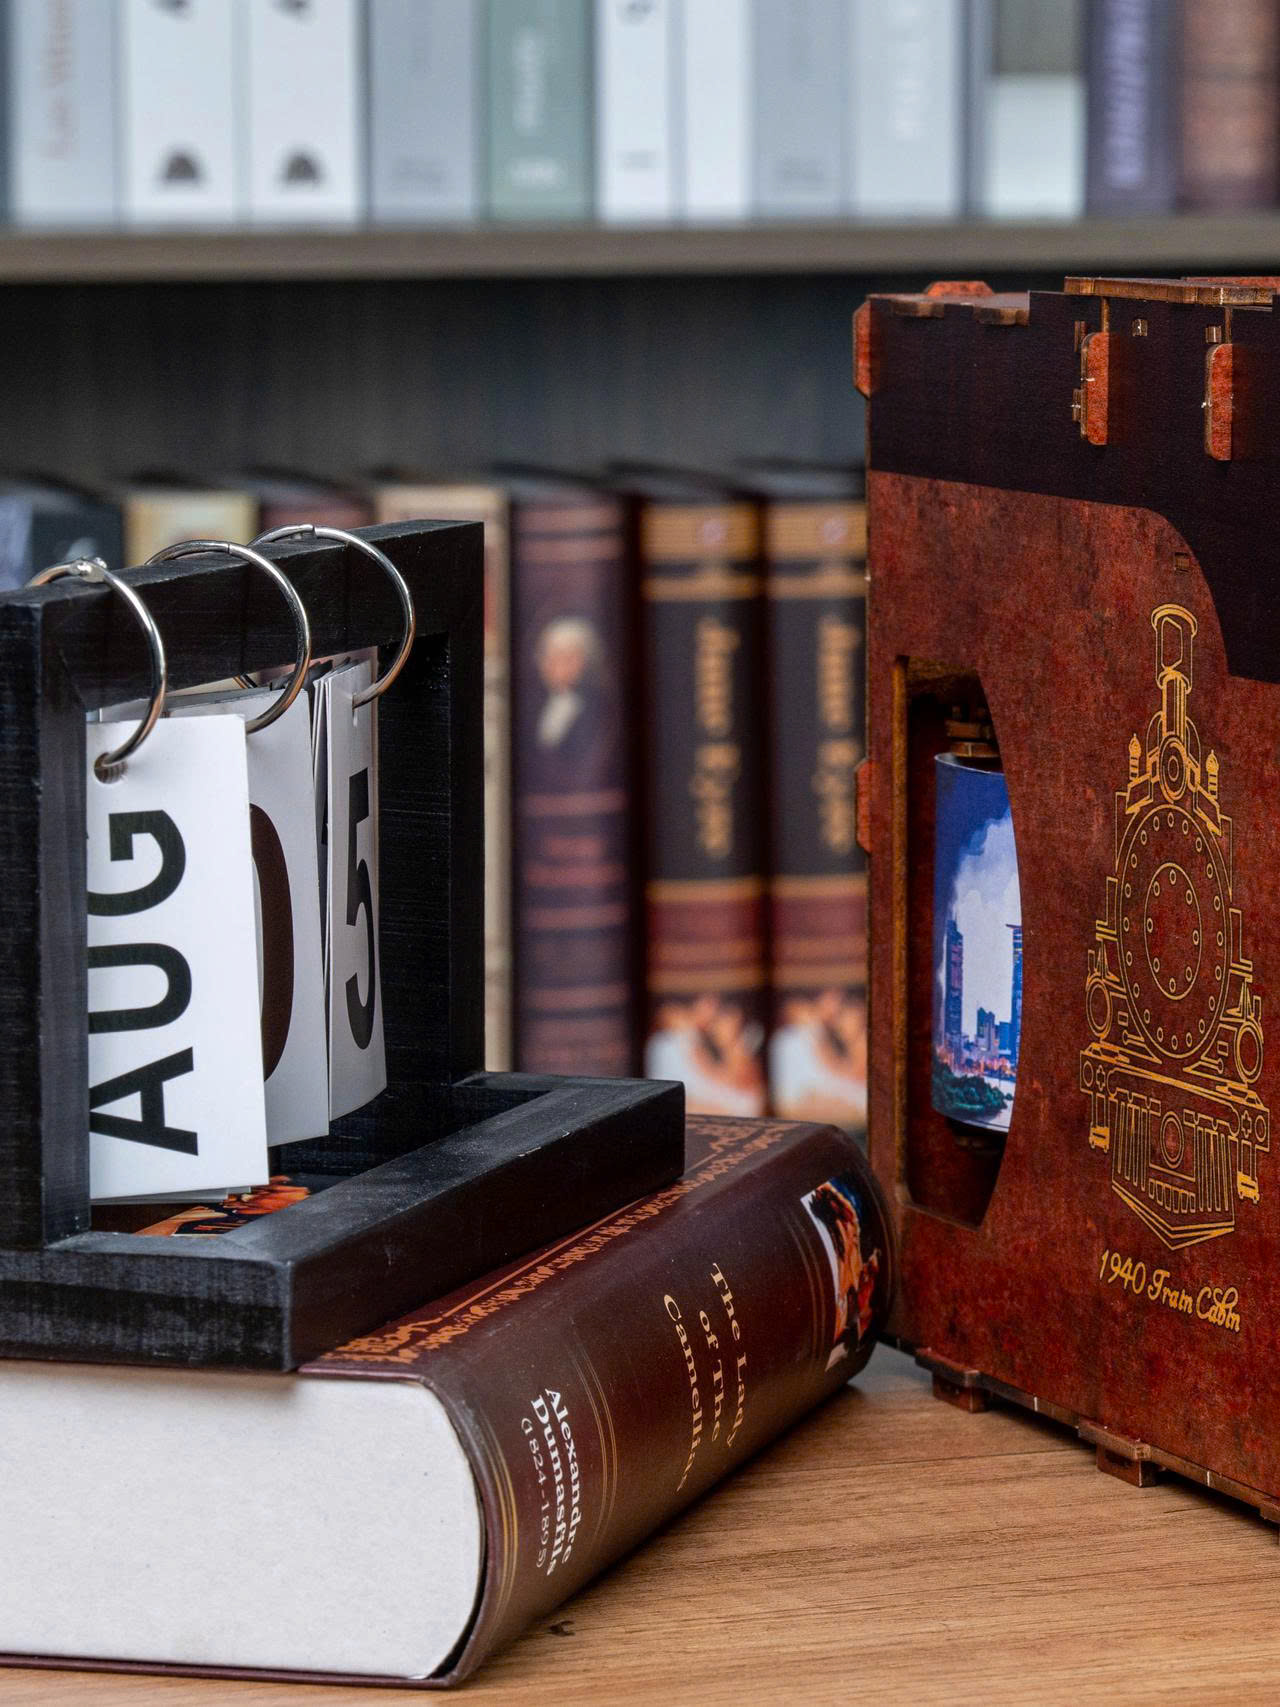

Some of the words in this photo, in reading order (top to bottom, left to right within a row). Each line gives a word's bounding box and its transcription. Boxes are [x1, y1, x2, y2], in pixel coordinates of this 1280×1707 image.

[86, 809, 199, 1157] AUG
[699, 1310, 720, 1350] of
[711, 1359, 725, 1442] The
[710, 1262, 742, 1342] The
[726, 1352, 747, 1448] Lady
[1099, 1249, 1147, 1295] 1940
[1147, 1268, 1194, 1314] Train
[1196, 1286, 1242, 1333] Cabin
[544, 1387, 582, 1565] Alexandre
